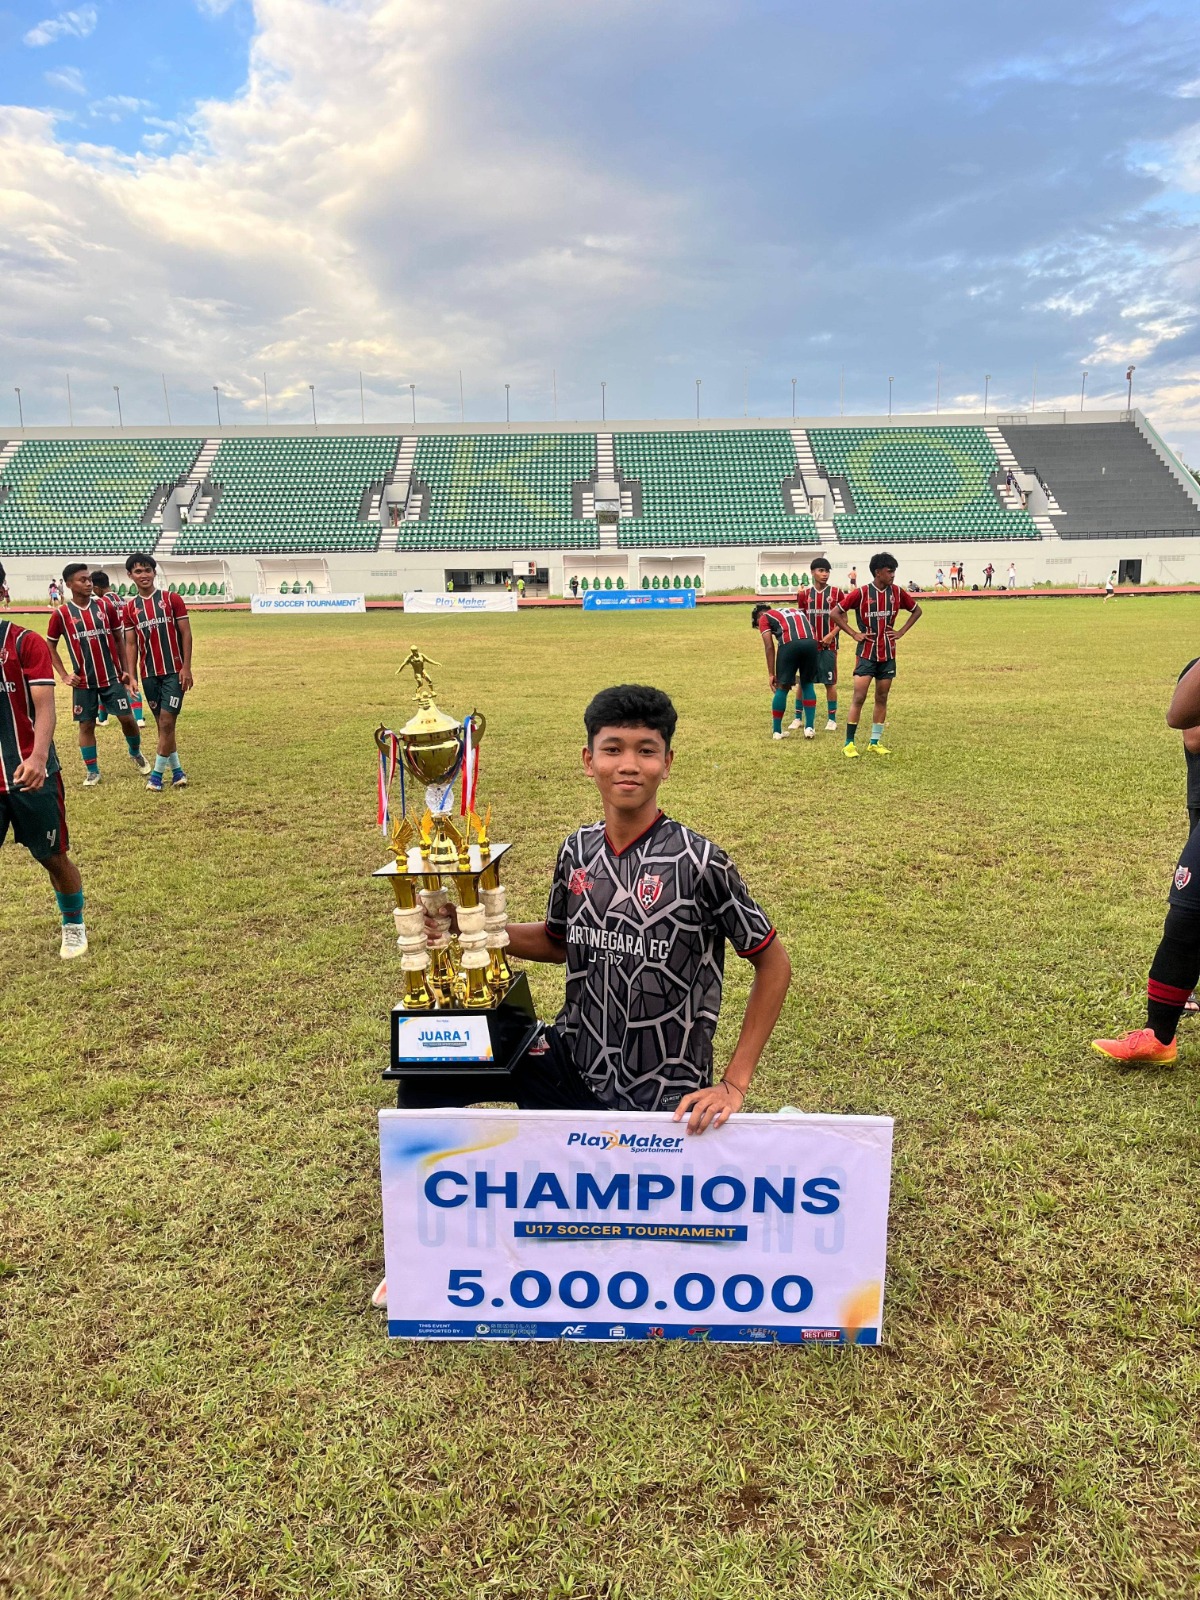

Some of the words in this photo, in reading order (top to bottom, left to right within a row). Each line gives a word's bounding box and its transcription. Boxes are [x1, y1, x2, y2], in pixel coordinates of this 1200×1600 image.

[442, 436, 563, 520] K
[259, 600, 272, 608] U17
[306, 599, 357, 607] TOURNAMENT
[435, 597, 456, 607] Play
[827, 671, 833, 681] 3
[5, 681, 16, 693] FC
[117, 698, 128, 710] 13
[169, 695, 180, 709] 10
[46, 828, 57, 847] 4
[649, 938, 669, 960] FC
[417, 1030, 462, 1041] JUARA
[464, 1030, 470, 1041] 1
[567, 1132, 613, 1150] Play
[618, 1133, 685, 1148] Maker
[424, 1170, 841, 1215] CHAMPIONS
[525, 1224, 552, 1235] U17
[556, 1225, 622, 1236] SOCCER
[625, 1226, 737, 1238] TOURNAMENT
[447, 1269, 815, 1313] 5.000.000
